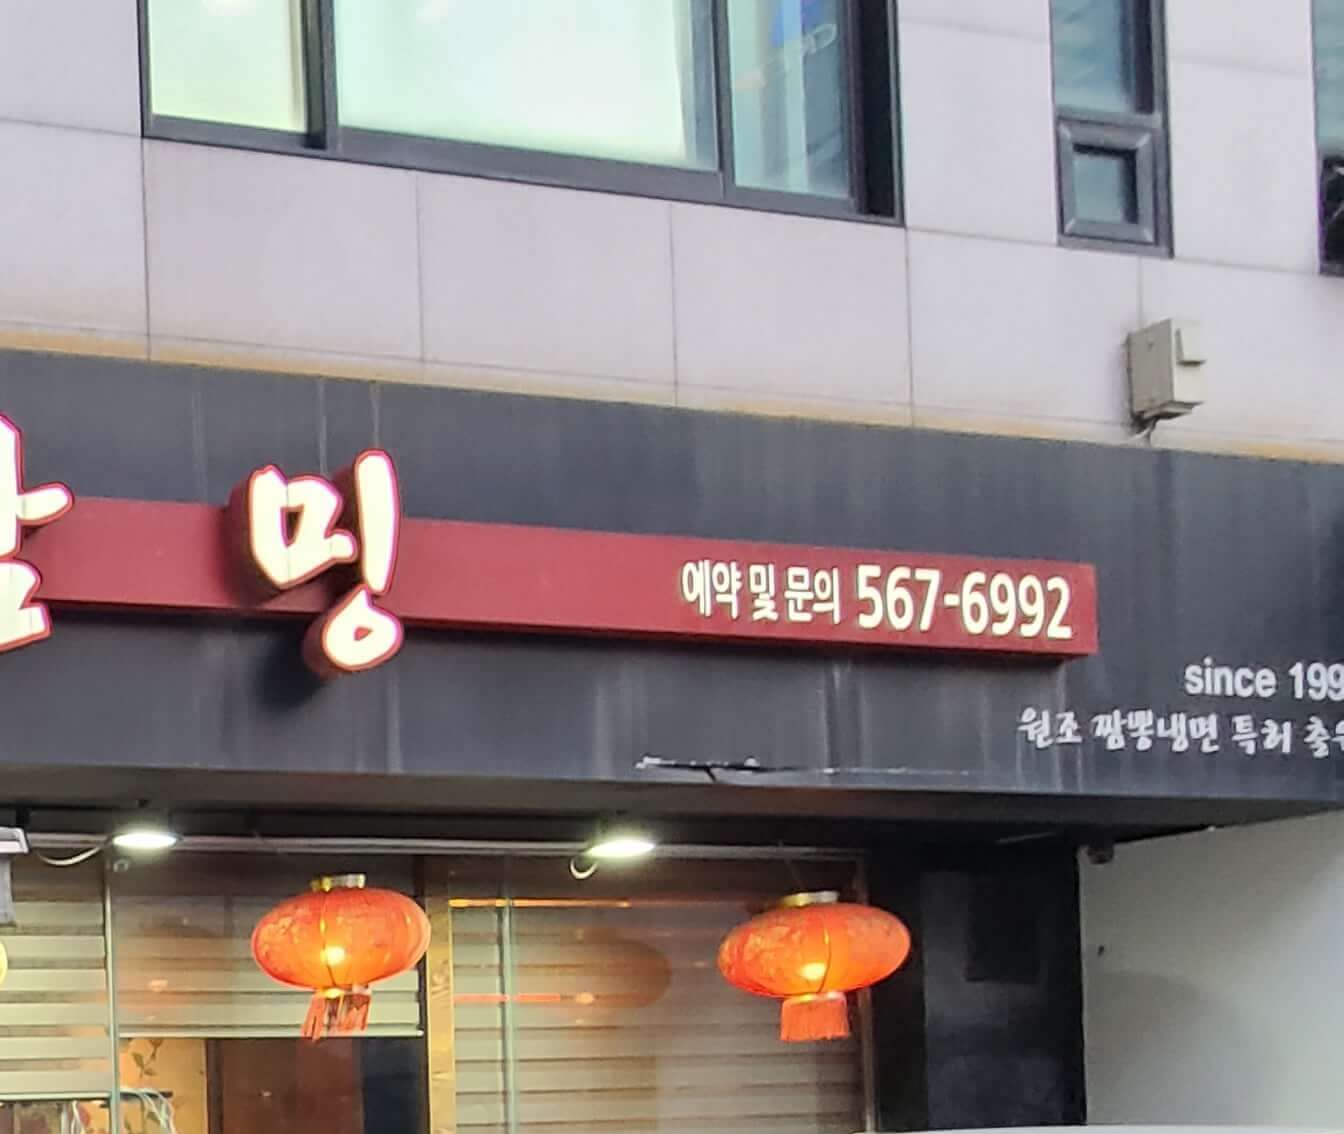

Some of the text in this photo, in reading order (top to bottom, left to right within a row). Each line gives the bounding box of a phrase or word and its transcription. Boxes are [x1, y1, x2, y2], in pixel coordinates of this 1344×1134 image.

[680, 558, 1074, 641] 예약 및 문의 567-6992
[1184, 656, 1278, 698] since
[1018, 706, 1083, 750] 원조
[1091, 708, 1220, 753] 짬뽕냉면
[1231, 714, 1292, 755] 특허
